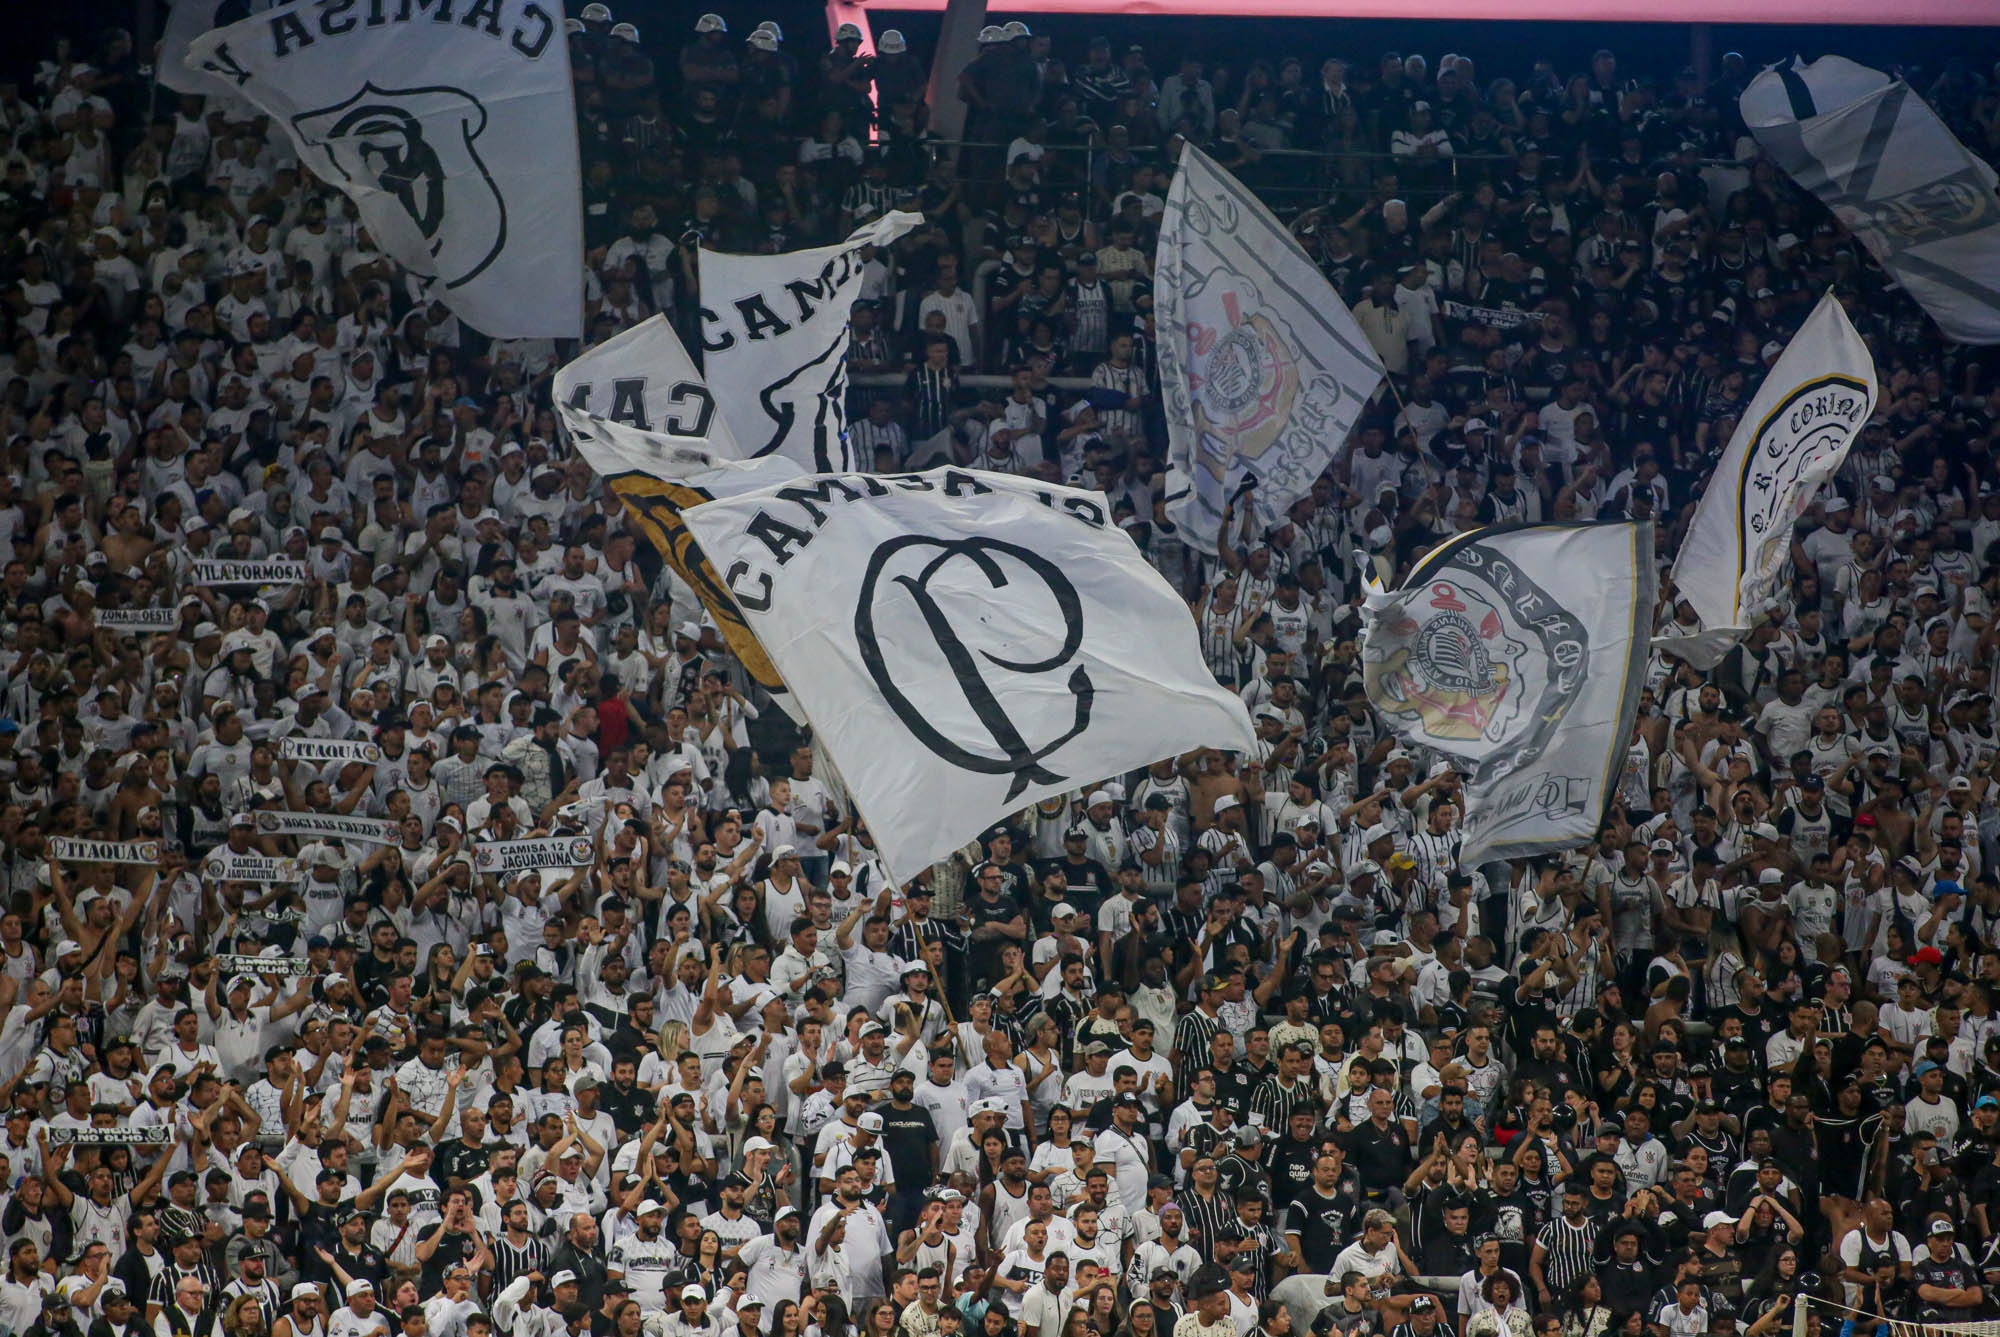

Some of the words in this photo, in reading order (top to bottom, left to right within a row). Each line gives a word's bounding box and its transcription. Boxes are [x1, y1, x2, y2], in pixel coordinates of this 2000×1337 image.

[231, 563, 305, 581] FORMOSA
[500, 843, 549, 856] CAMISA
[551, 842, 565, 852] 12
[502, 851, 572, 870] JAGUARIUNA
[235, 965, 254, 973] NO
[257, 966, 290, 975] OLHO
[78, 1134, 99, 1142] NO
[103, 1134, 145, 1142] OLHO
